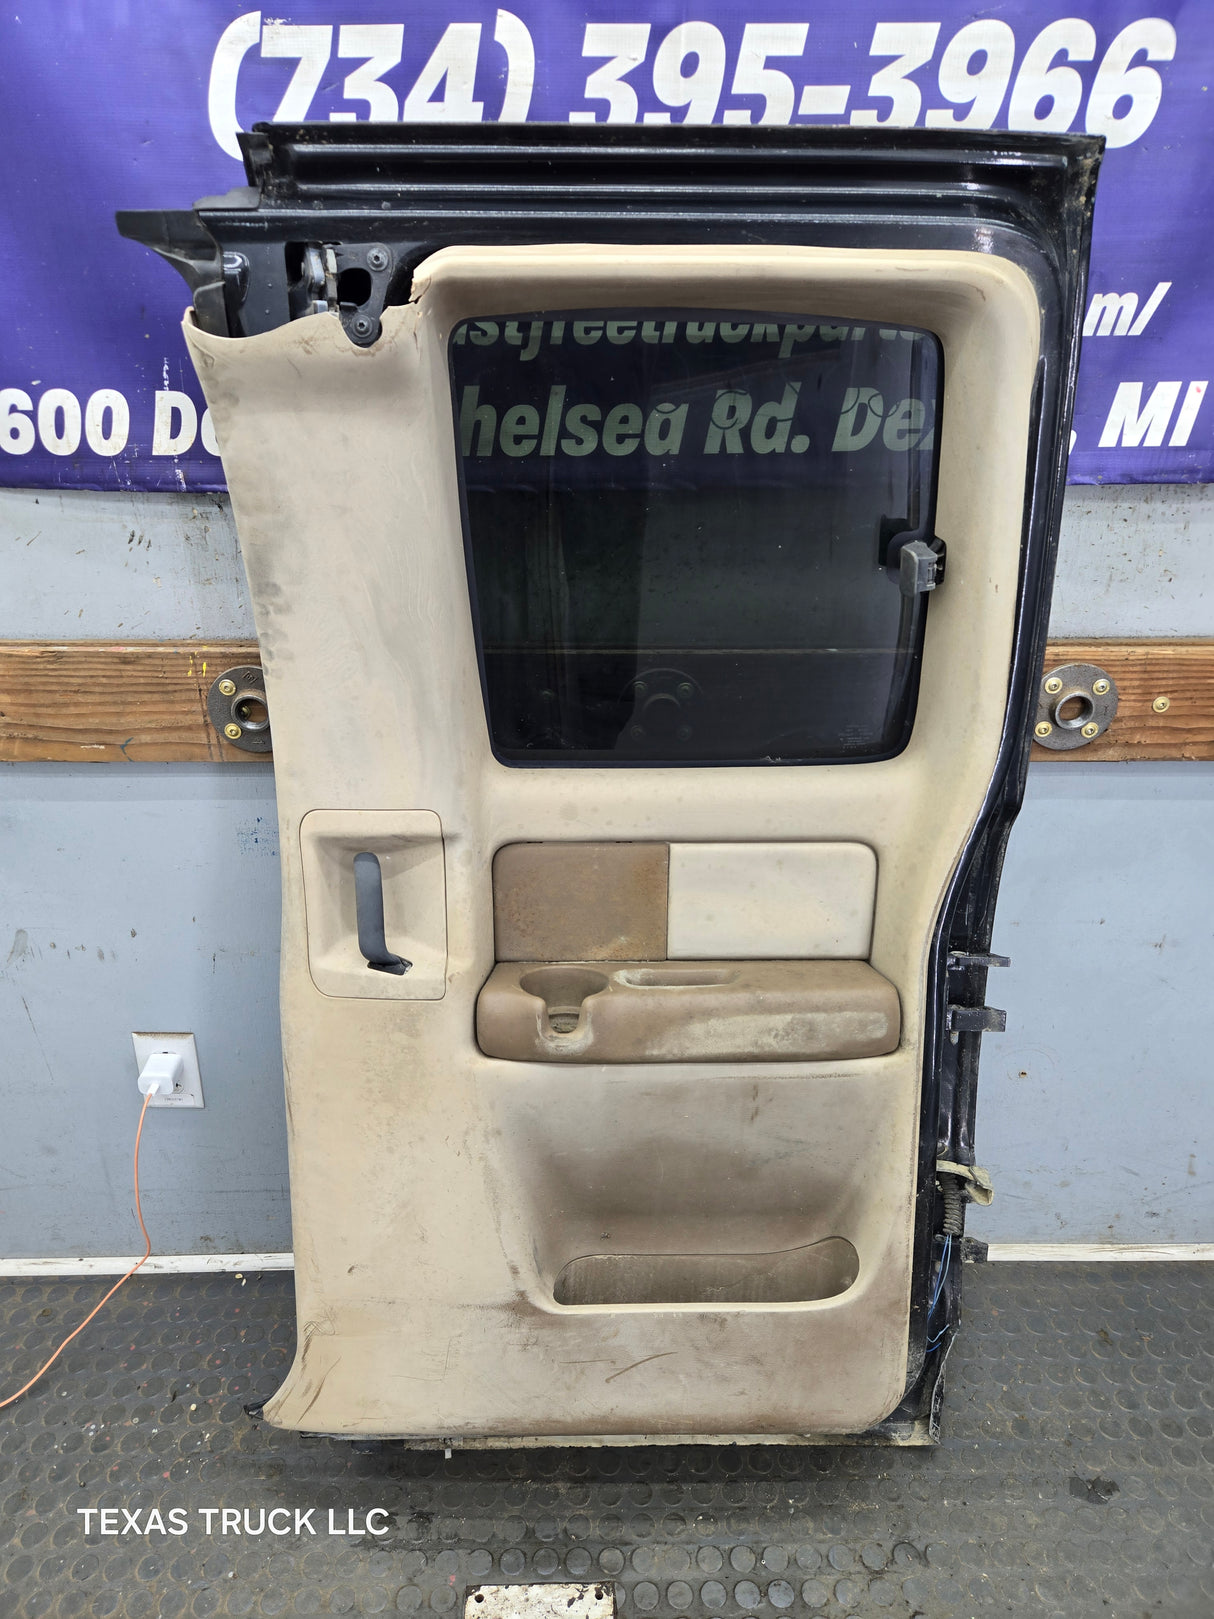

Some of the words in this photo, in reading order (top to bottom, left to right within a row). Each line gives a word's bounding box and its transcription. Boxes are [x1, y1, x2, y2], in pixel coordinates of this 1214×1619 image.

[208, 9, 535, 160] (734)
[568, 18, 1177, 148] 395-3966
[0, 388, 130, 456] 600
[704, 382, 811, 455] Rd.
[1098, 381, 1209, 447] MI
